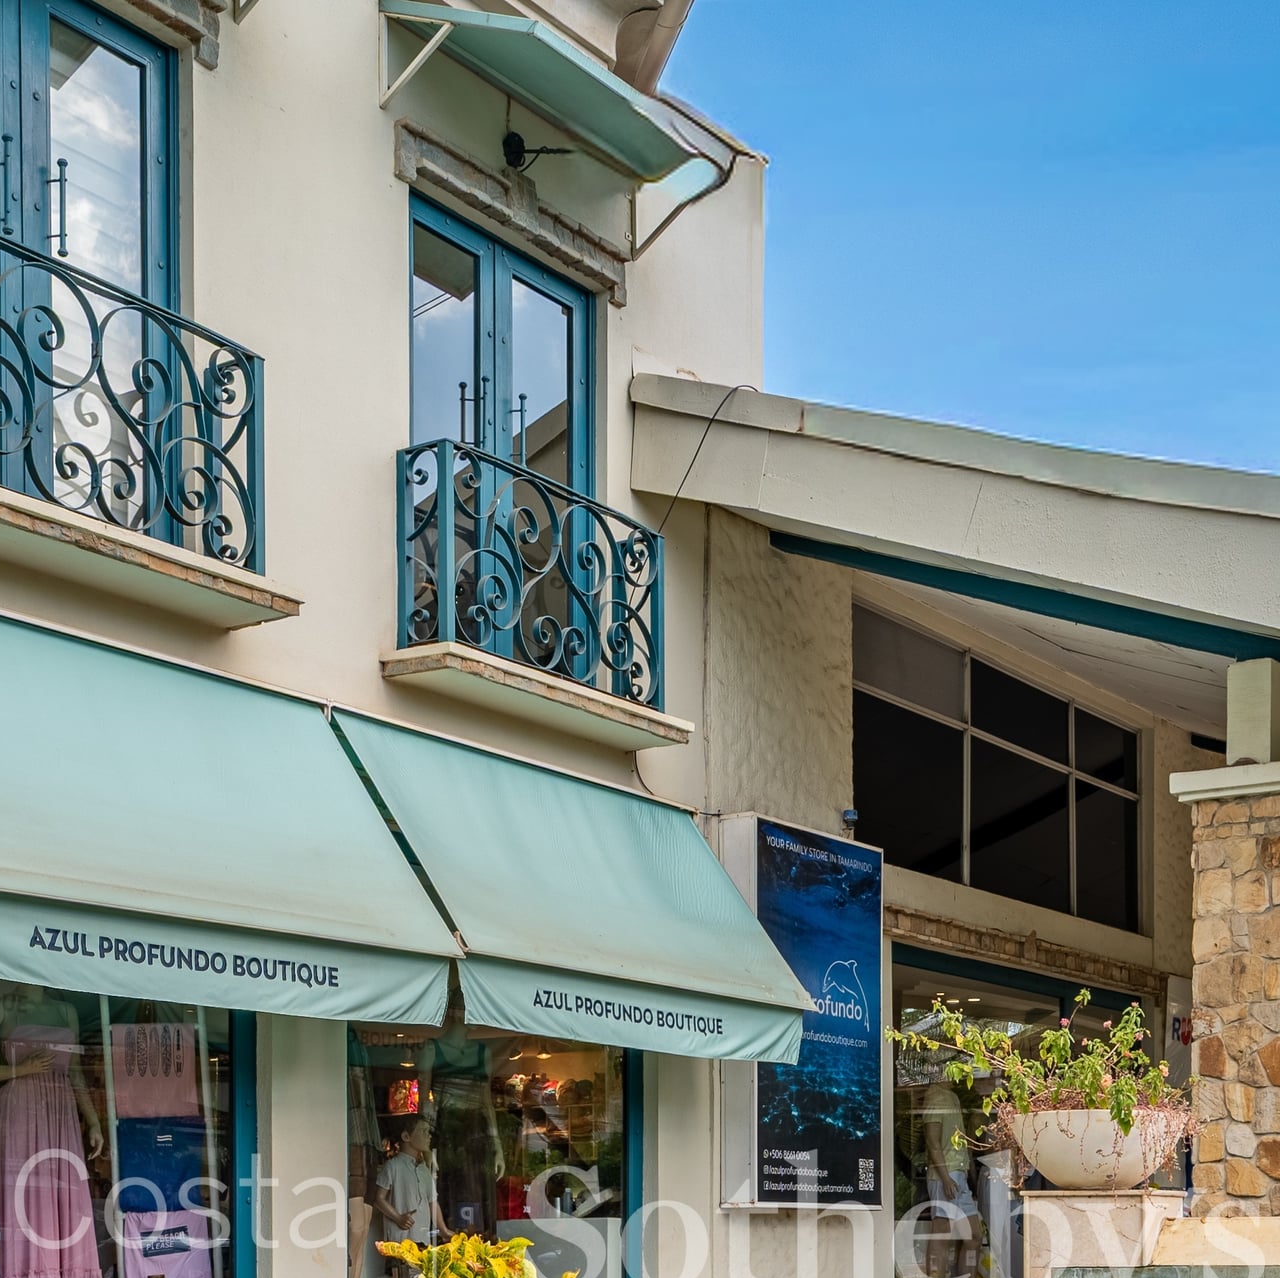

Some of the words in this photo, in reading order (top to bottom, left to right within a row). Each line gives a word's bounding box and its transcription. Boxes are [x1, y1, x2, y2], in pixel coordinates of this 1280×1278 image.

[766, 835, 785, 848] YOUR
[785, 841, 808, 856] FAMILY
[809, 847, 828, 861] STORE
[829, 853, 837, 863] IN
[837, 855, 872, 873] TAMARINDO
[29, 925, 95, 957] AZUL
[99, 936, 227, 974] PROFUNDO
[232, 955, 339, 988] BOUTIQUE
[533, 989, 572, 1012] AZUL
[575, 996, 653, 1025] PROFUNDO
[657, 1010, 723, 1036] BOUTIQUE
[146, 1240, 175, 1251] PLEASE
